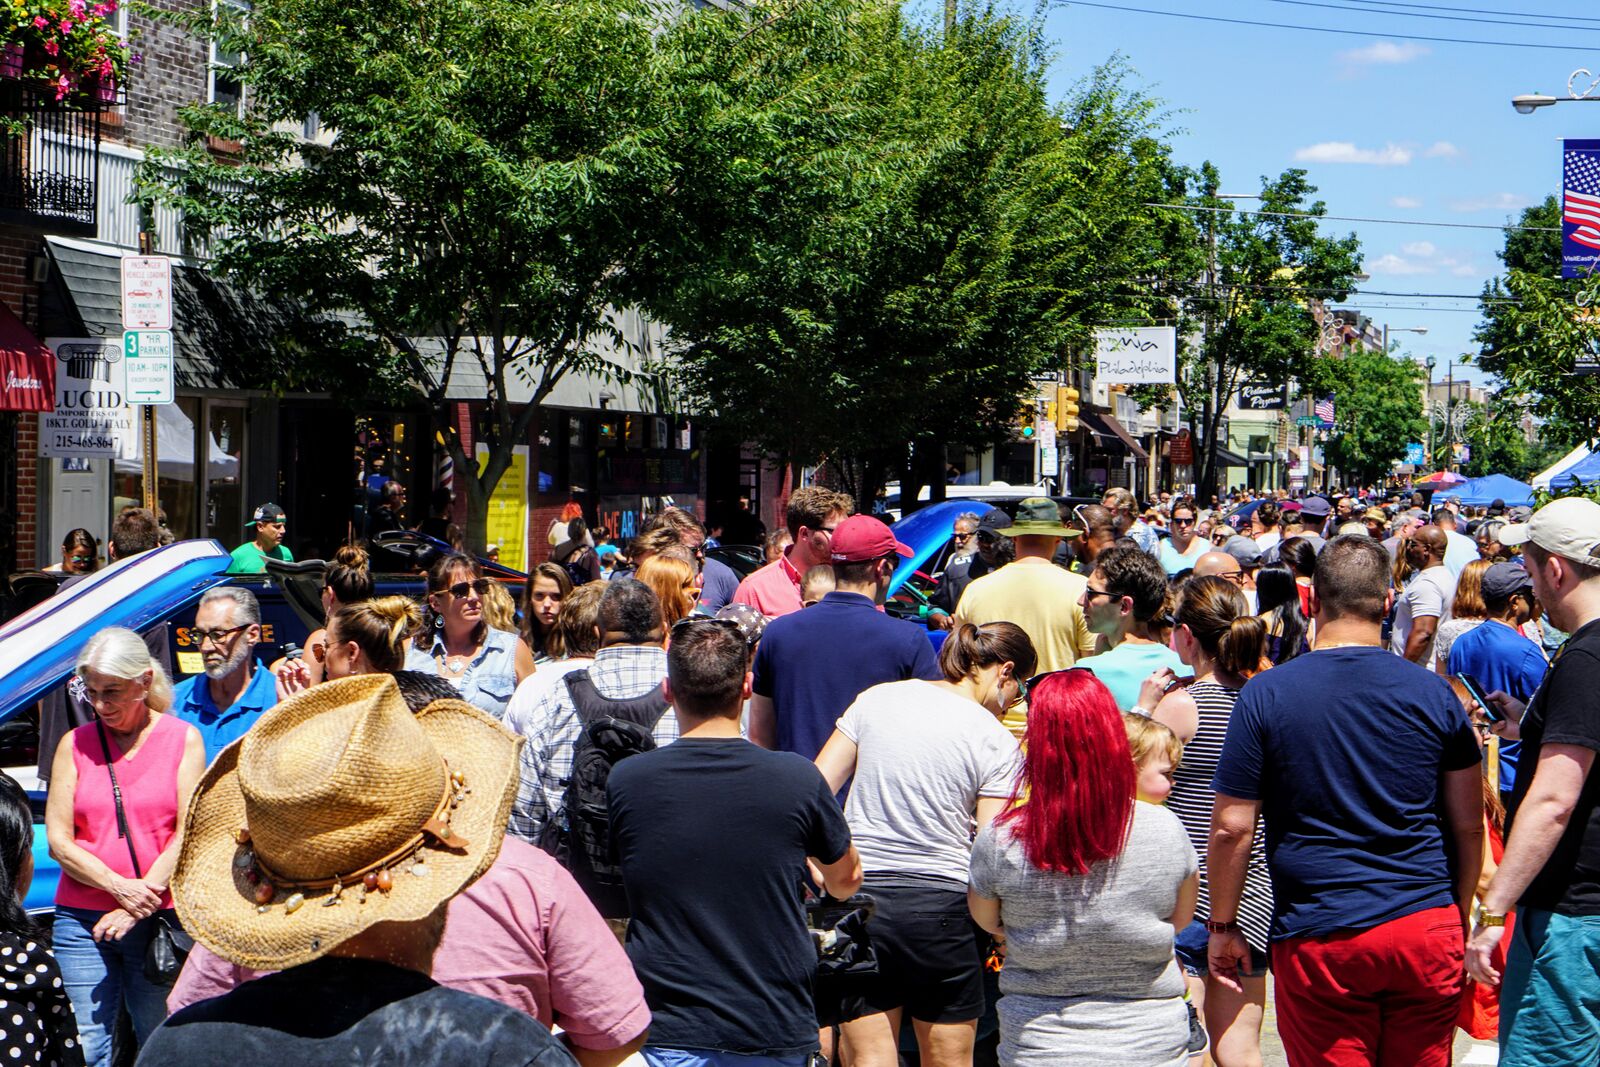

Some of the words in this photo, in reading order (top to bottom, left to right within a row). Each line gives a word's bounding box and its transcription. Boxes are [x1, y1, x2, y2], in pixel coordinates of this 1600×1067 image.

[127, 335, 137, 354] 3
[149, 335, 161, 343] HR
[140, 346, 169, 355] PARKING
[1099, 360, 1169, 379] Philadelphia
[5, 370, 42, 393] Jewelers
[54, 390, 131, 409] UCID
[46, 419, 69, 428] 18KT.
[71, 419, 98, 428] GOLD
[105, 419, 131, 429] ITALY
[56, 435, 119, 449] 215-468-8647
[603, 511, 620, 539] WE
